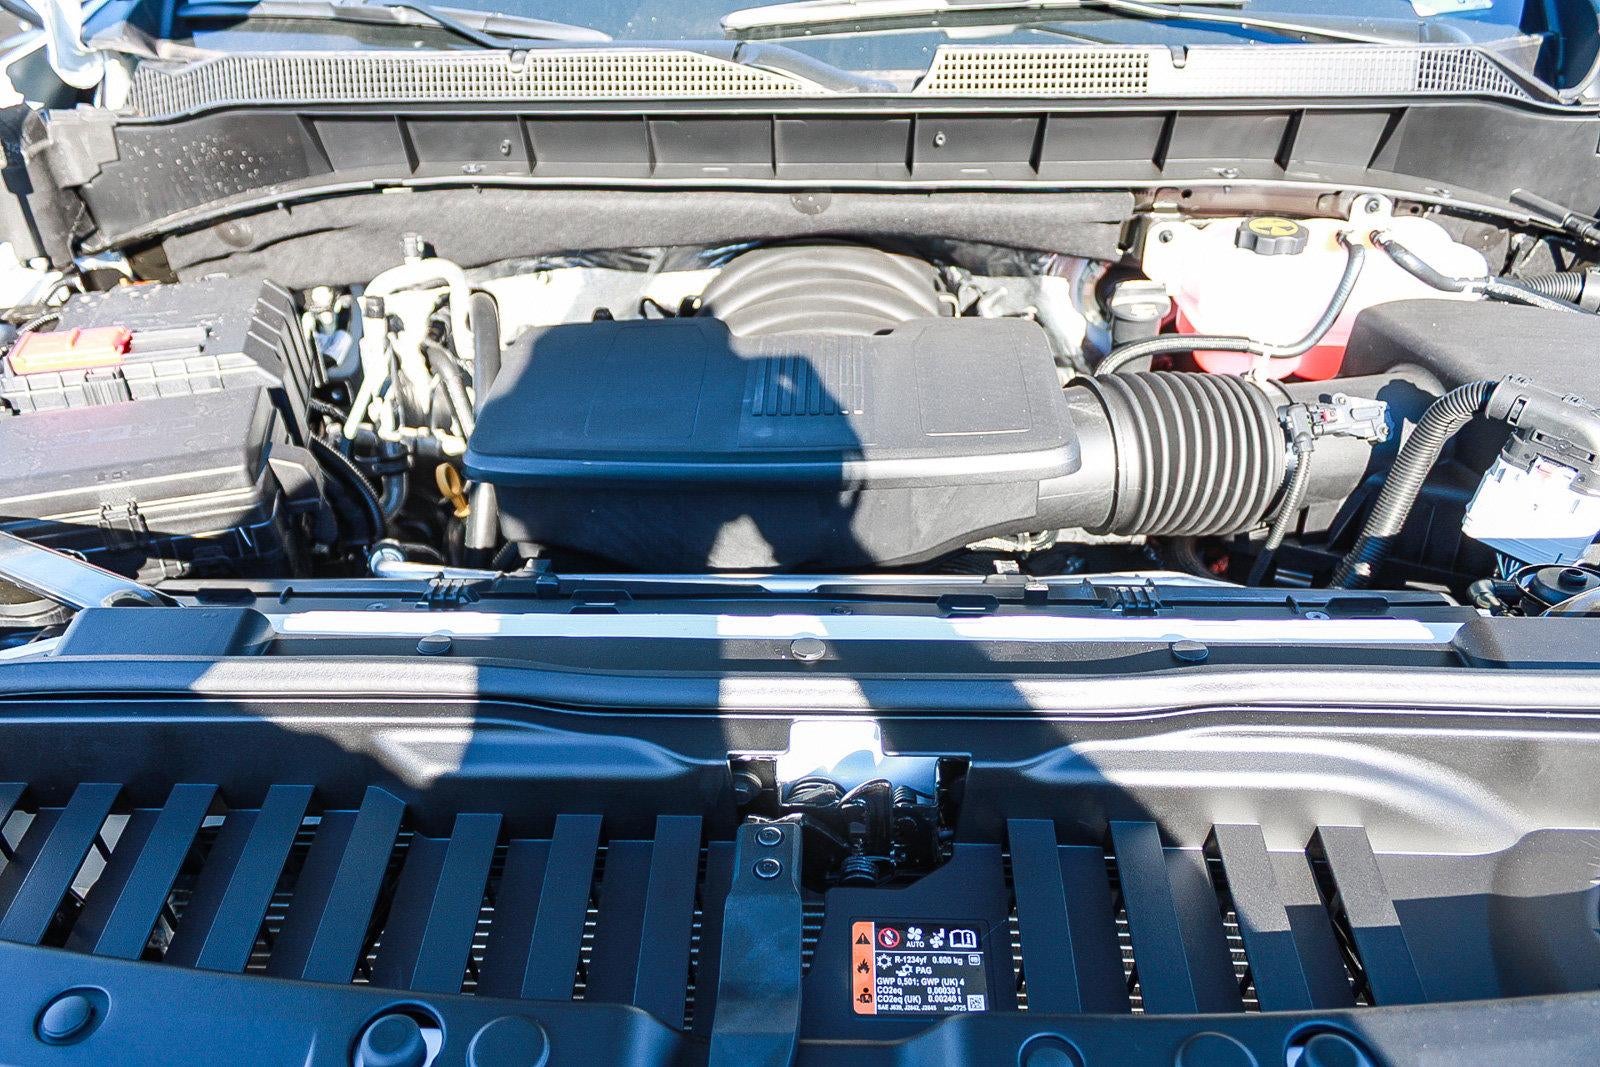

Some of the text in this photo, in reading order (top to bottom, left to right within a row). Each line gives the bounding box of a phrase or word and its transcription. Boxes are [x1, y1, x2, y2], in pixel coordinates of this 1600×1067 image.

[894, 956, 927, 965] R-1234yf
[953, 956, 963, 966] kg
[897, 978, 919, 986] 0,501;
[941, 978, 958, 987] (UK)
[877, 986, 902, 995] CO2eq
[877, 995, 903, 1004] CO2eq
[904, 995, 921, 1004] (UK)
